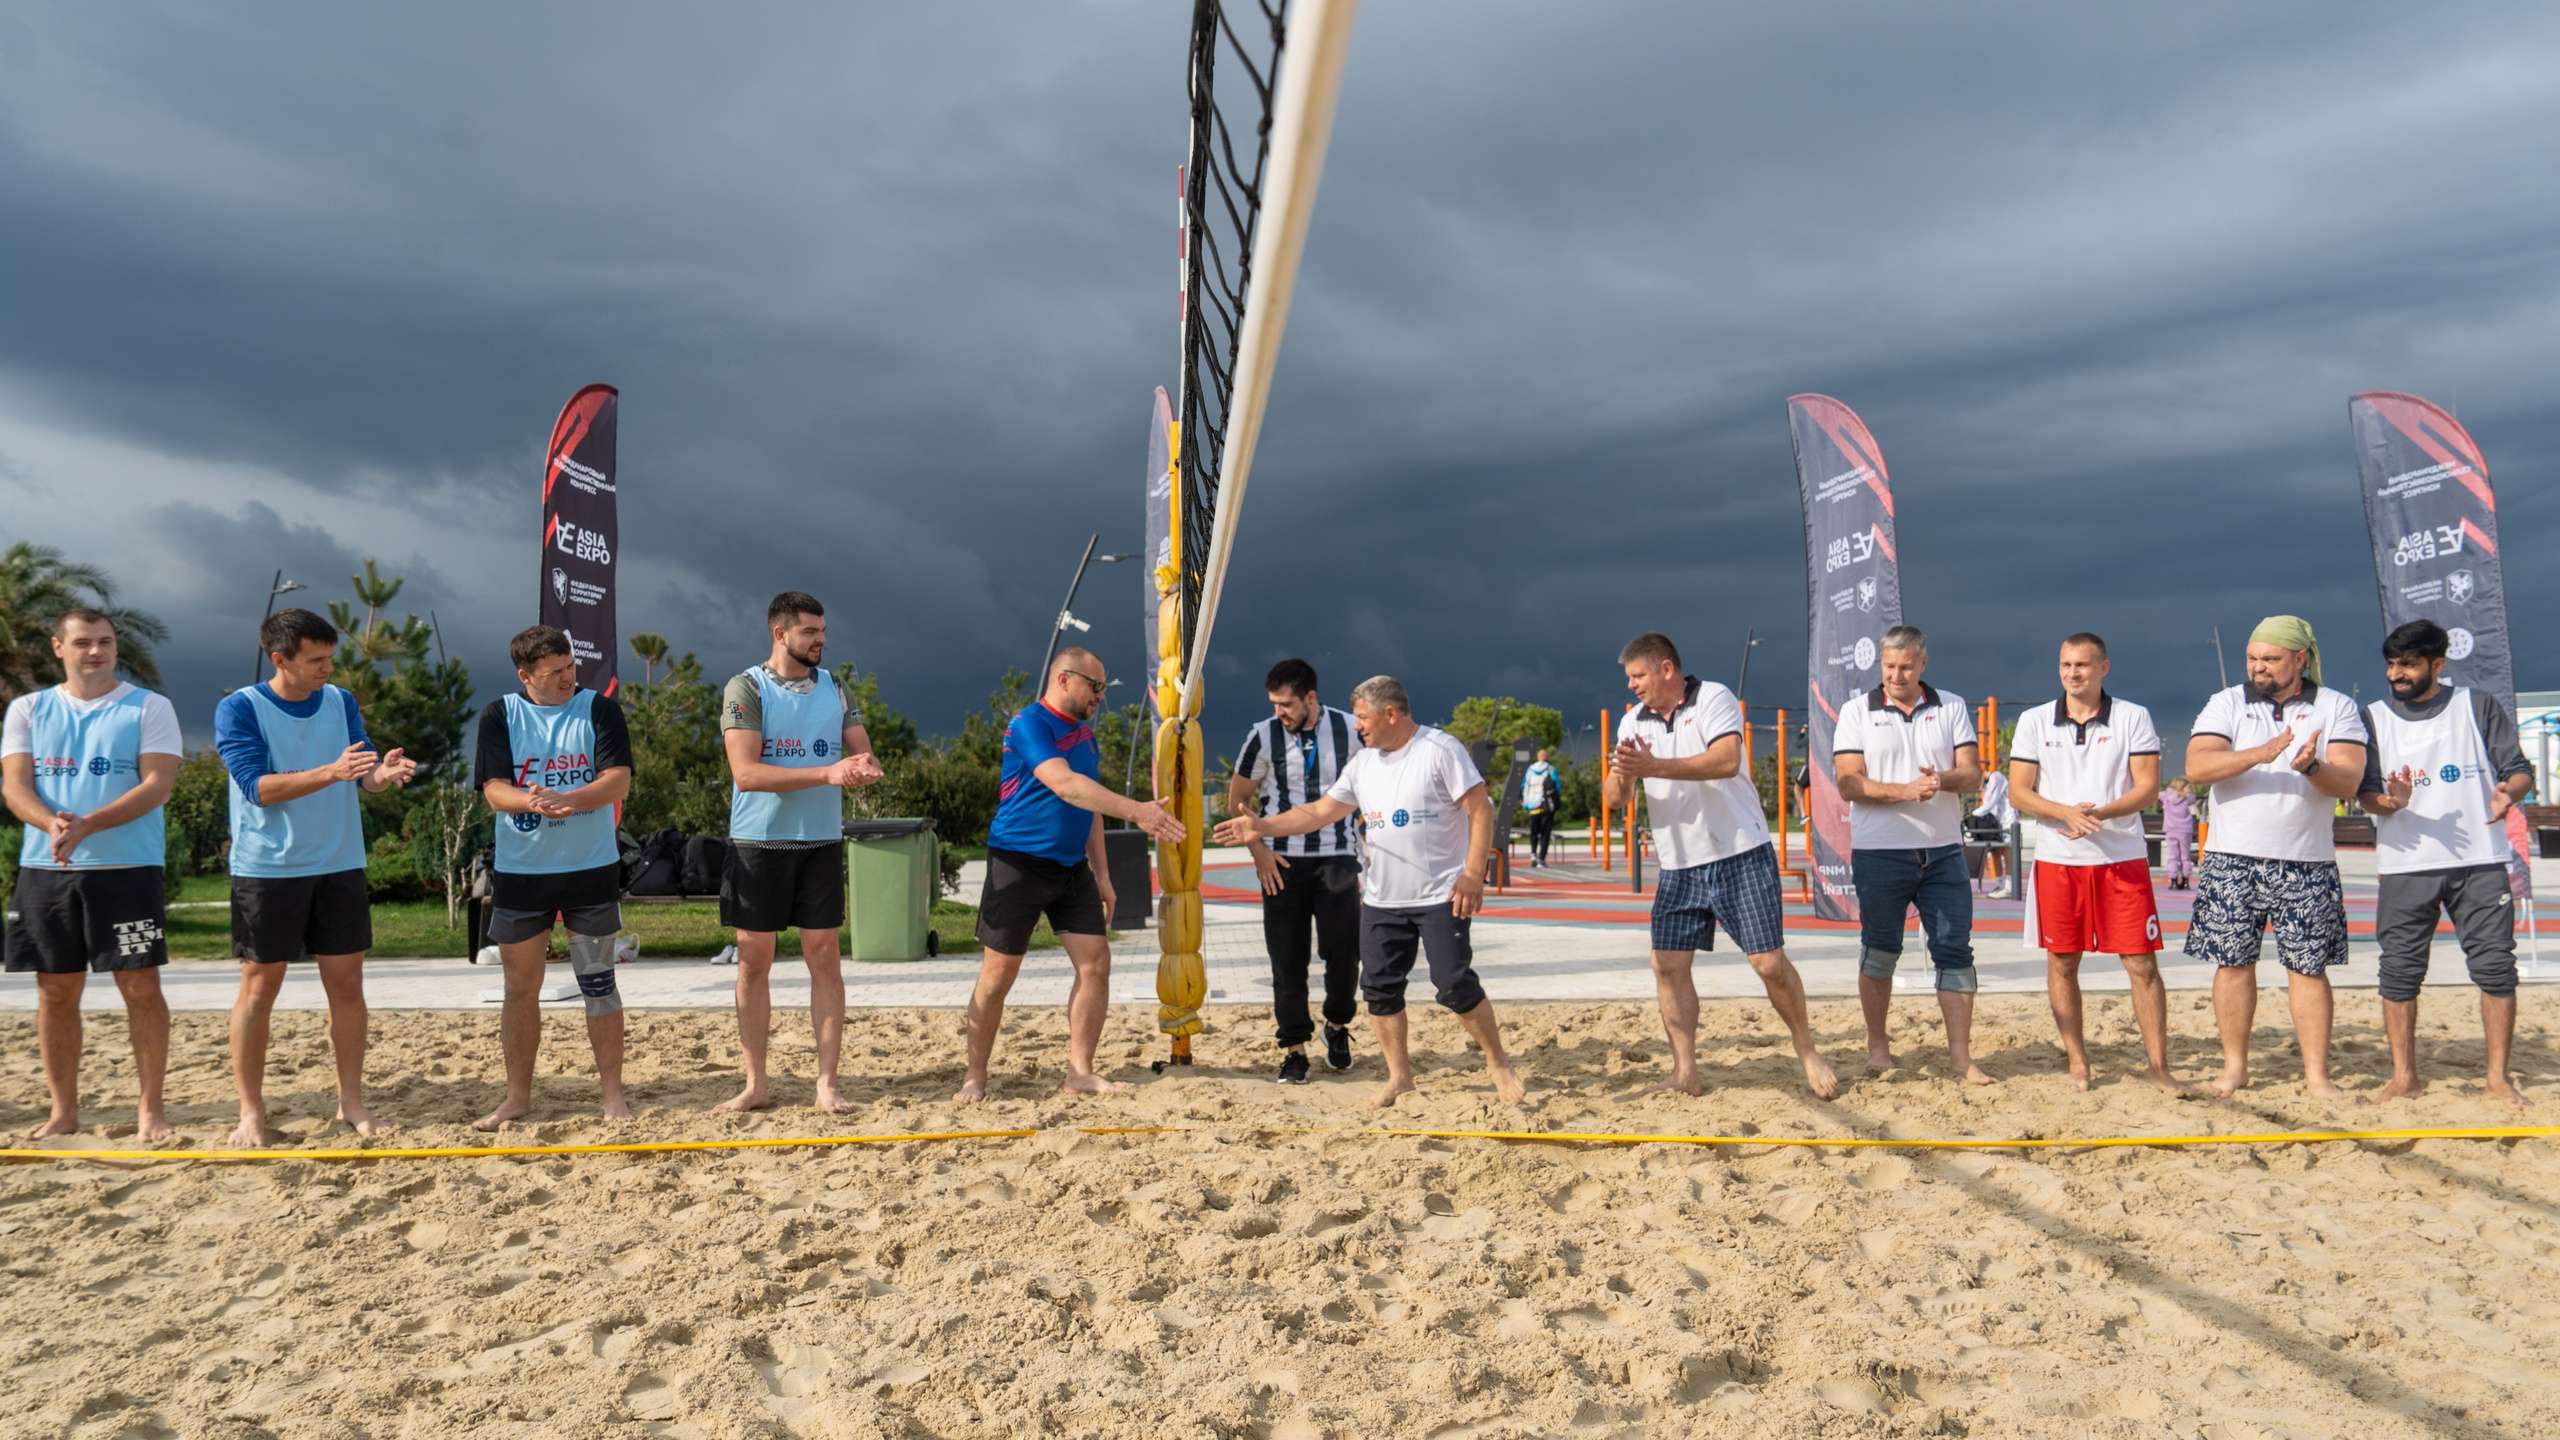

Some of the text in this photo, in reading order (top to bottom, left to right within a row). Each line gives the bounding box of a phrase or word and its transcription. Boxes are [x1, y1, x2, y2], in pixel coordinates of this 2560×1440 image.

[577, 527, 607, 549] ASIA
[576, 542, 611, 565] EXPO
[776, 738, 802, 747] ASIA
[776, 749, 806, 757] EXPO
[45, 757, 75, 767] ASIA
[545, 753, 589, 772] ASIA
[45, 767, 79, 777] EXPO
[545, 769, 594, 788] EXPO
[548, 820, 566, 828] ВИК
[113, 918, 155, 934] TE
[2145, 914, 2159, 941] 6
[119, 941, 153, 957] IT
